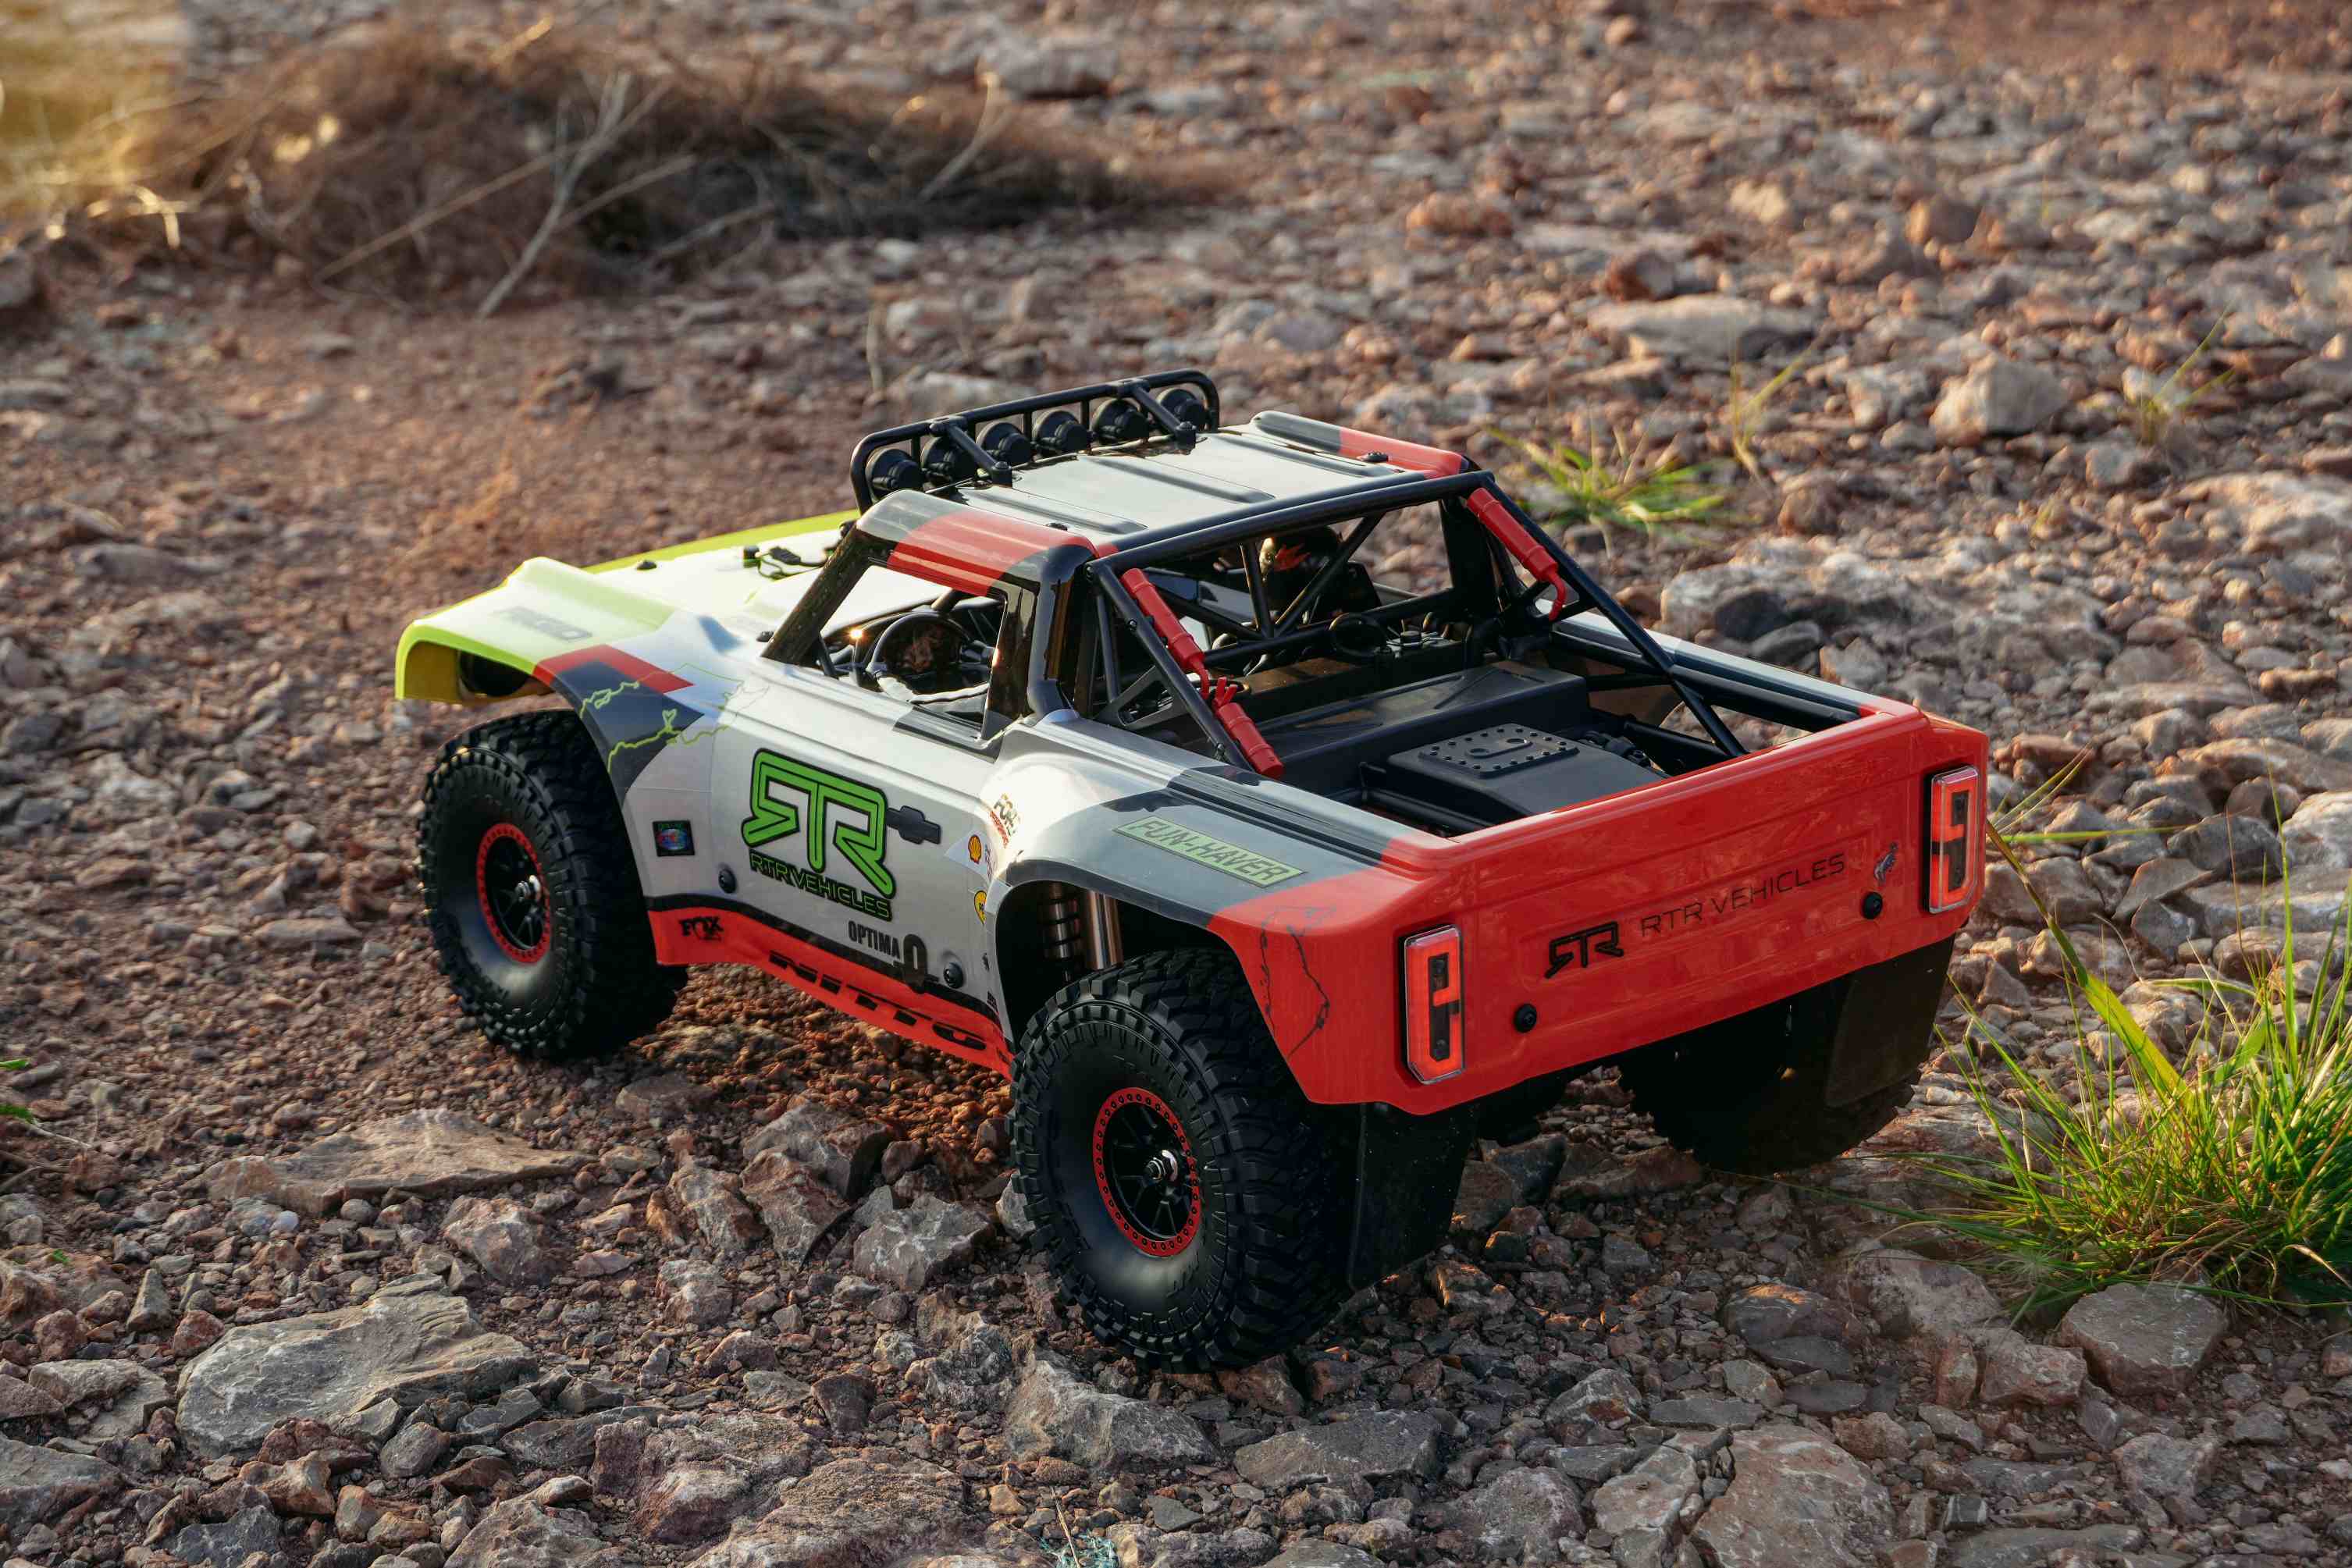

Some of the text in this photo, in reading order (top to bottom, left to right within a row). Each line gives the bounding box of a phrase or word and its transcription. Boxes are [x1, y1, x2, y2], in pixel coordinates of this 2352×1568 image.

[741, 748, 897, 900] RTR
[1130, 820, 1291, 881] FUN-HAVER
[749, 849, 892, 922] RTR VEHICLES
[1544, 852, 1845, 980] RTR RTR VEHICLES
[848, 920, 901, 960] OPTIMA
